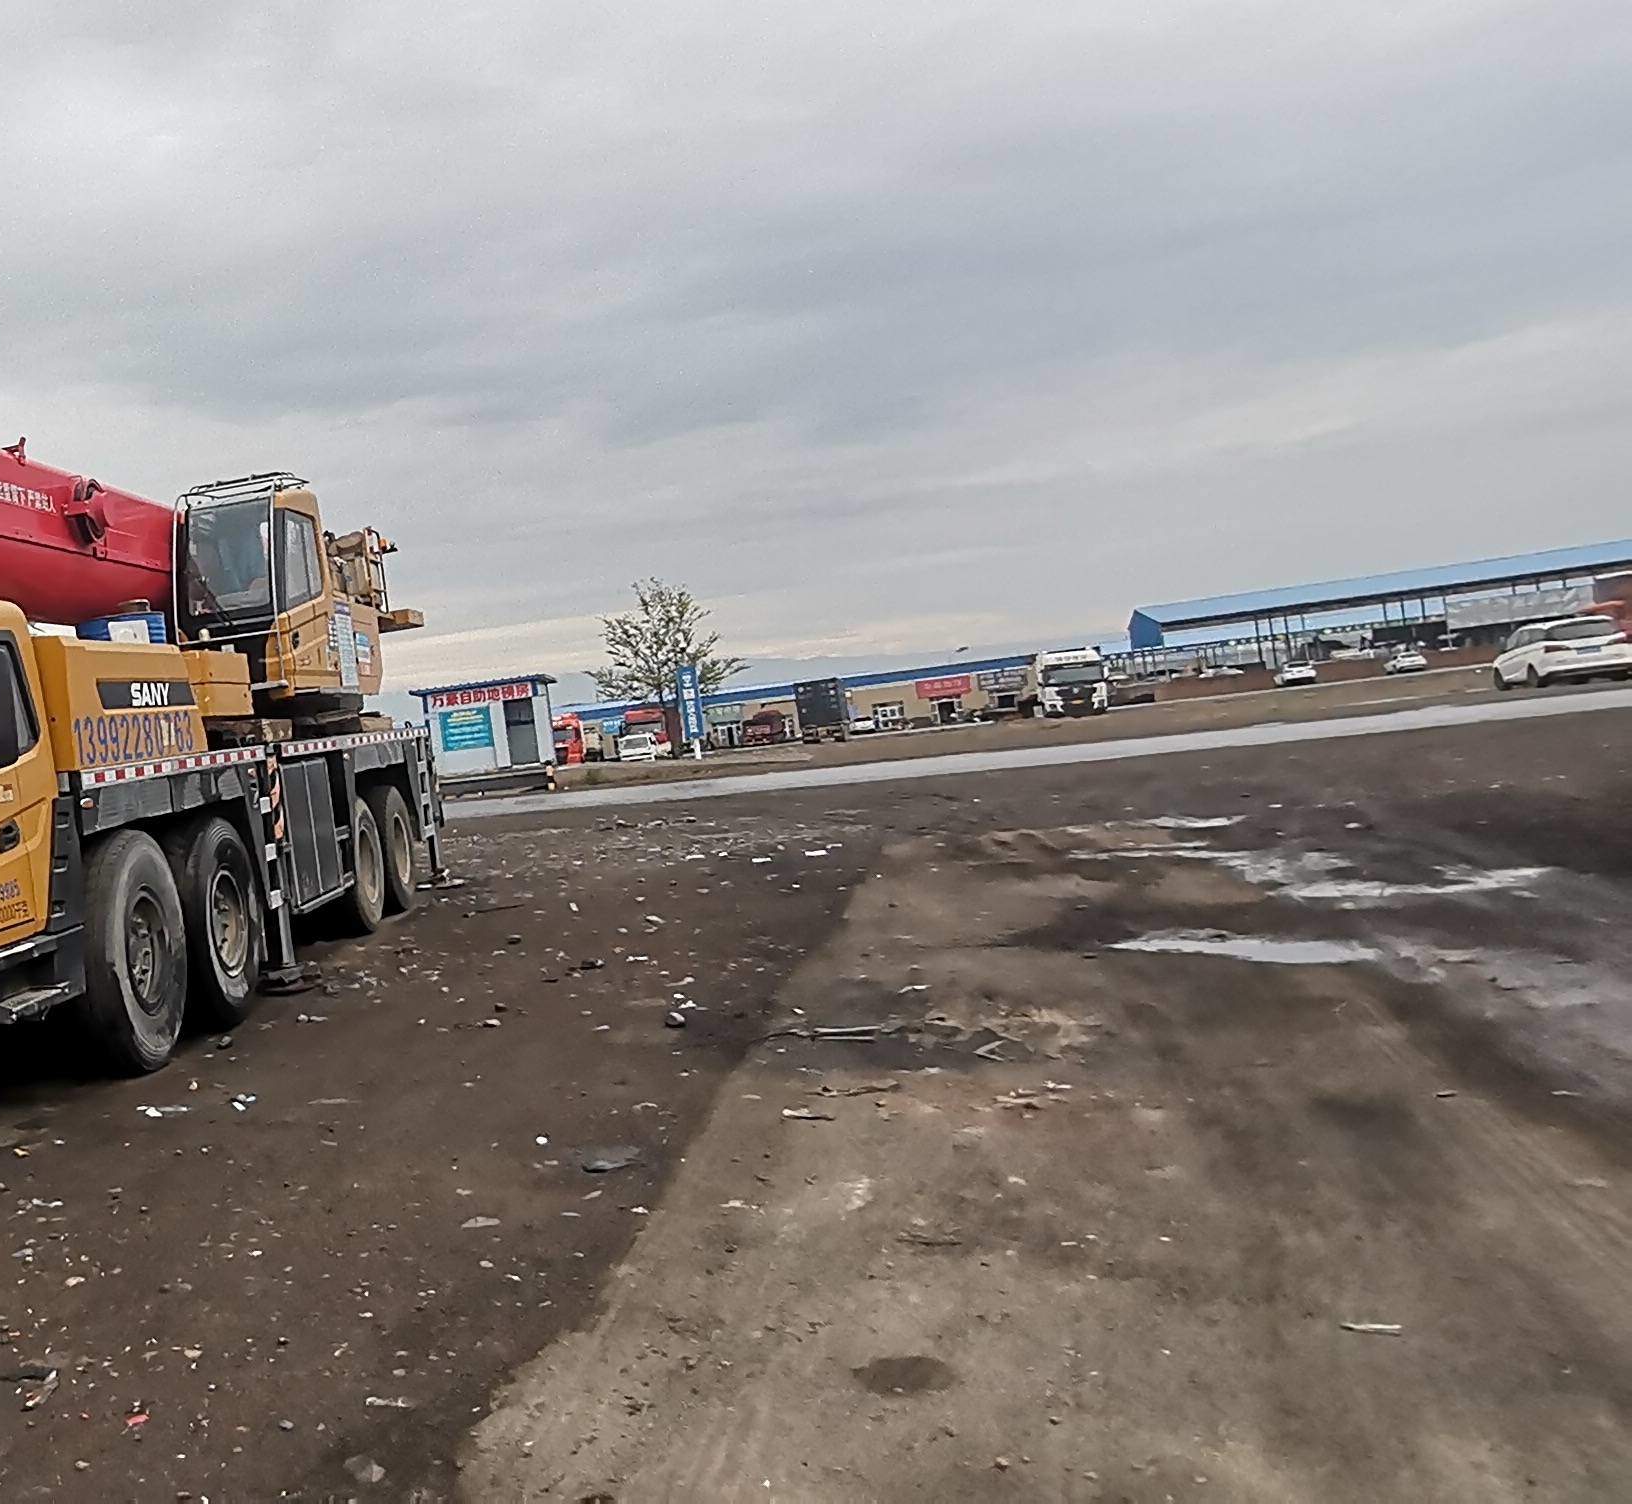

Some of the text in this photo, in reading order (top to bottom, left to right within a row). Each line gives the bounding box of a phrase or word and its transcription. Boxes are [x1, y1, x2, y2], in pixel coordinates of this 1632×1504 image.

[130, 682, 170, 706] SANY
[431, 683, 530, 708] 万豪自助地磅房
